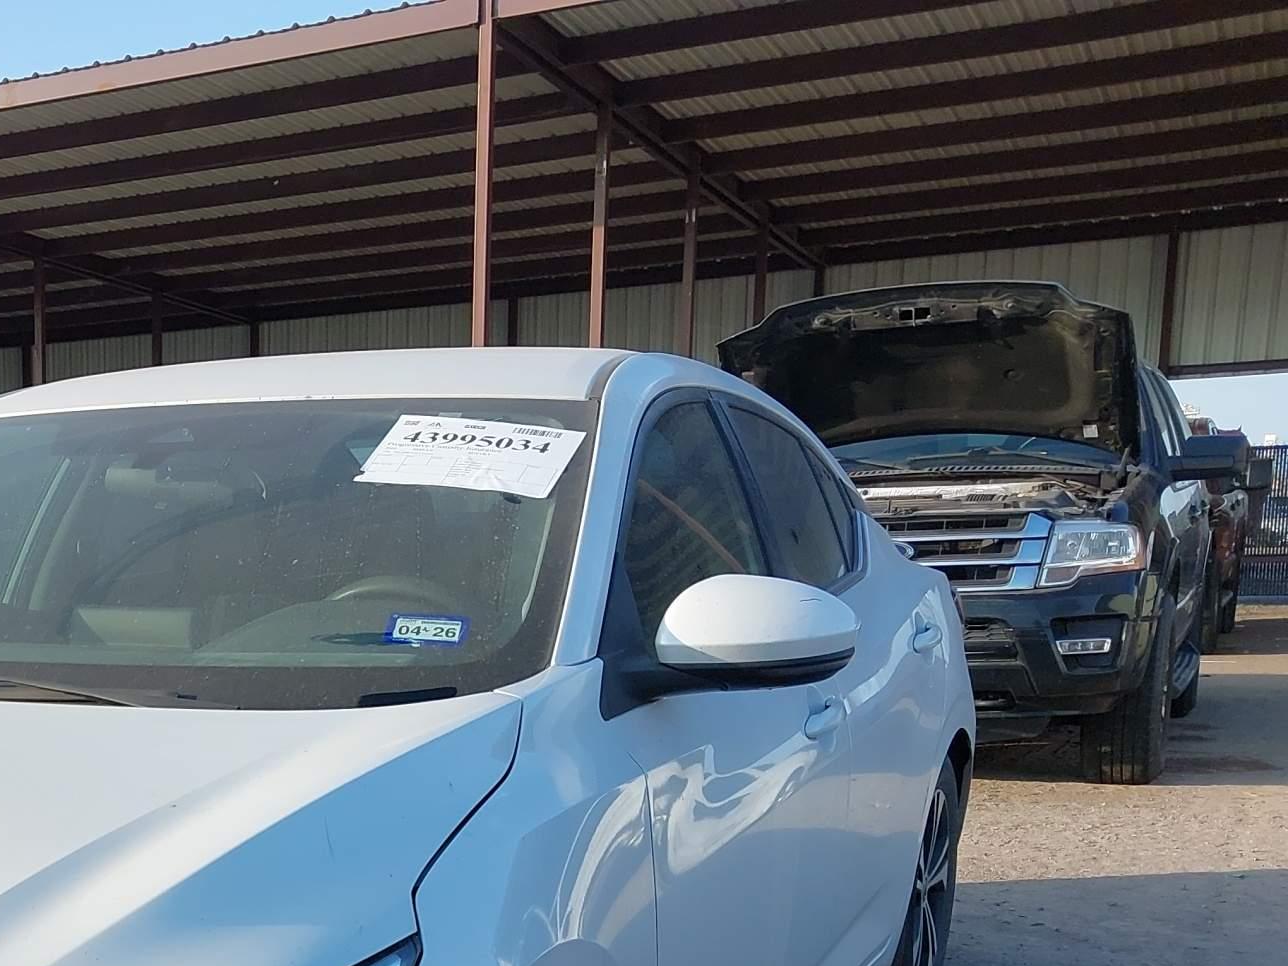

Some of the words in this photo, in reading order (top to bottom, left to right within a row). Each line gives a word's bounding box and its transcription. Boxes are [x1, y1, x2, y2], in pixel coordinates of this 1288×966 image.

[403, 430, 552, 454] 43995034
[398, 625, 422, 636] 04
[432, 626, 457, 638] 26
